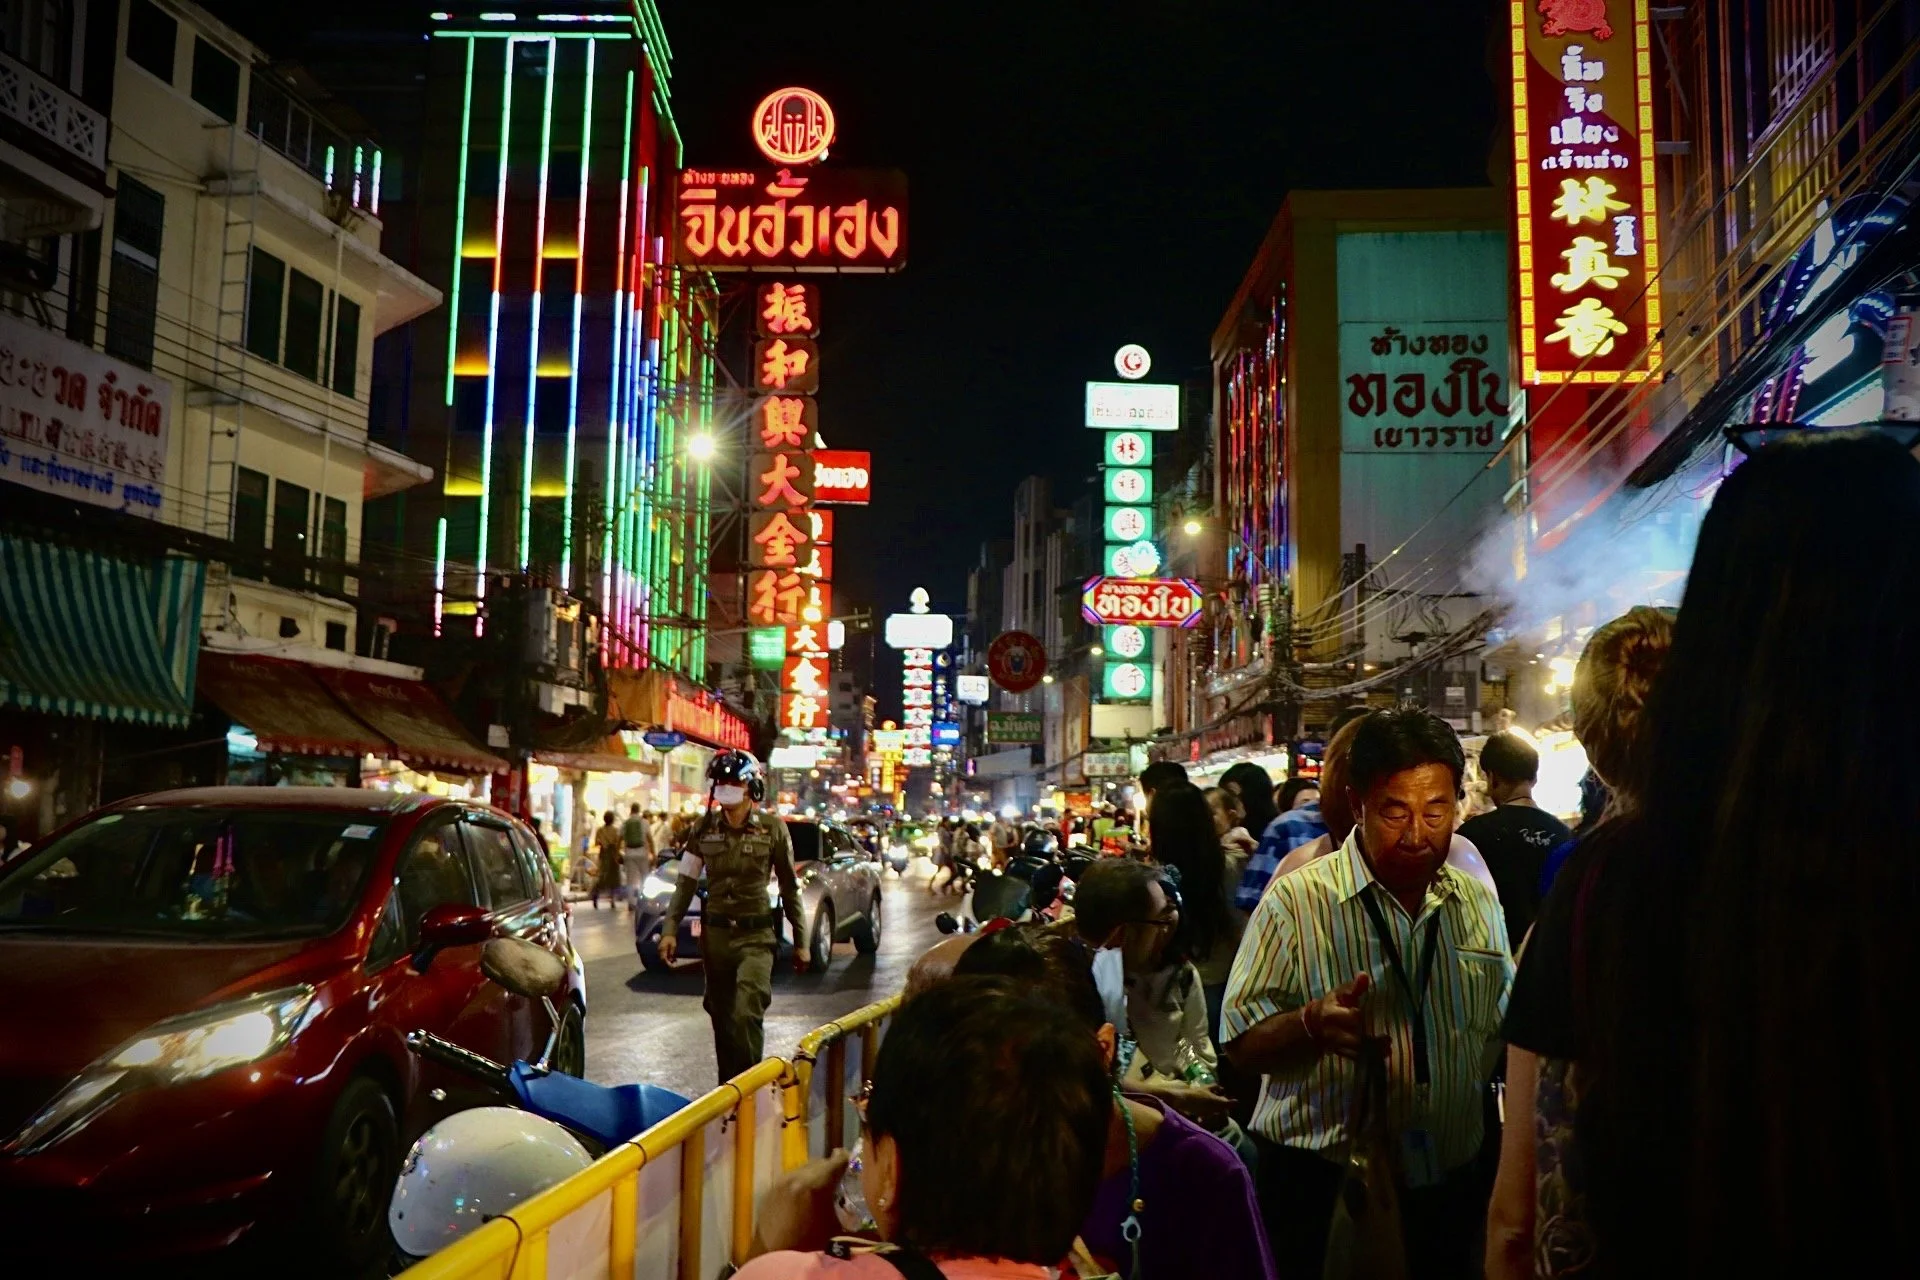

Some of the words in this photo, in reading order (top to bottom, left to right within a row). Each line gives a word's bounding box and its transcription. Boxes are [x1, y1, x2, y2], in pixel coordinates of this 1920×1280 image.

[1543, 176, 1631, 357] 林真香
[1370, 327, 1488, 355] ห้างทอง
[99, 370, 161, 437] จำกัด
[753, 282, 812, 622] 振和興大金行
[1374, 421, 1493, 447] เยาวราช
[1096, 586, 1190, 618] ทองใบ
